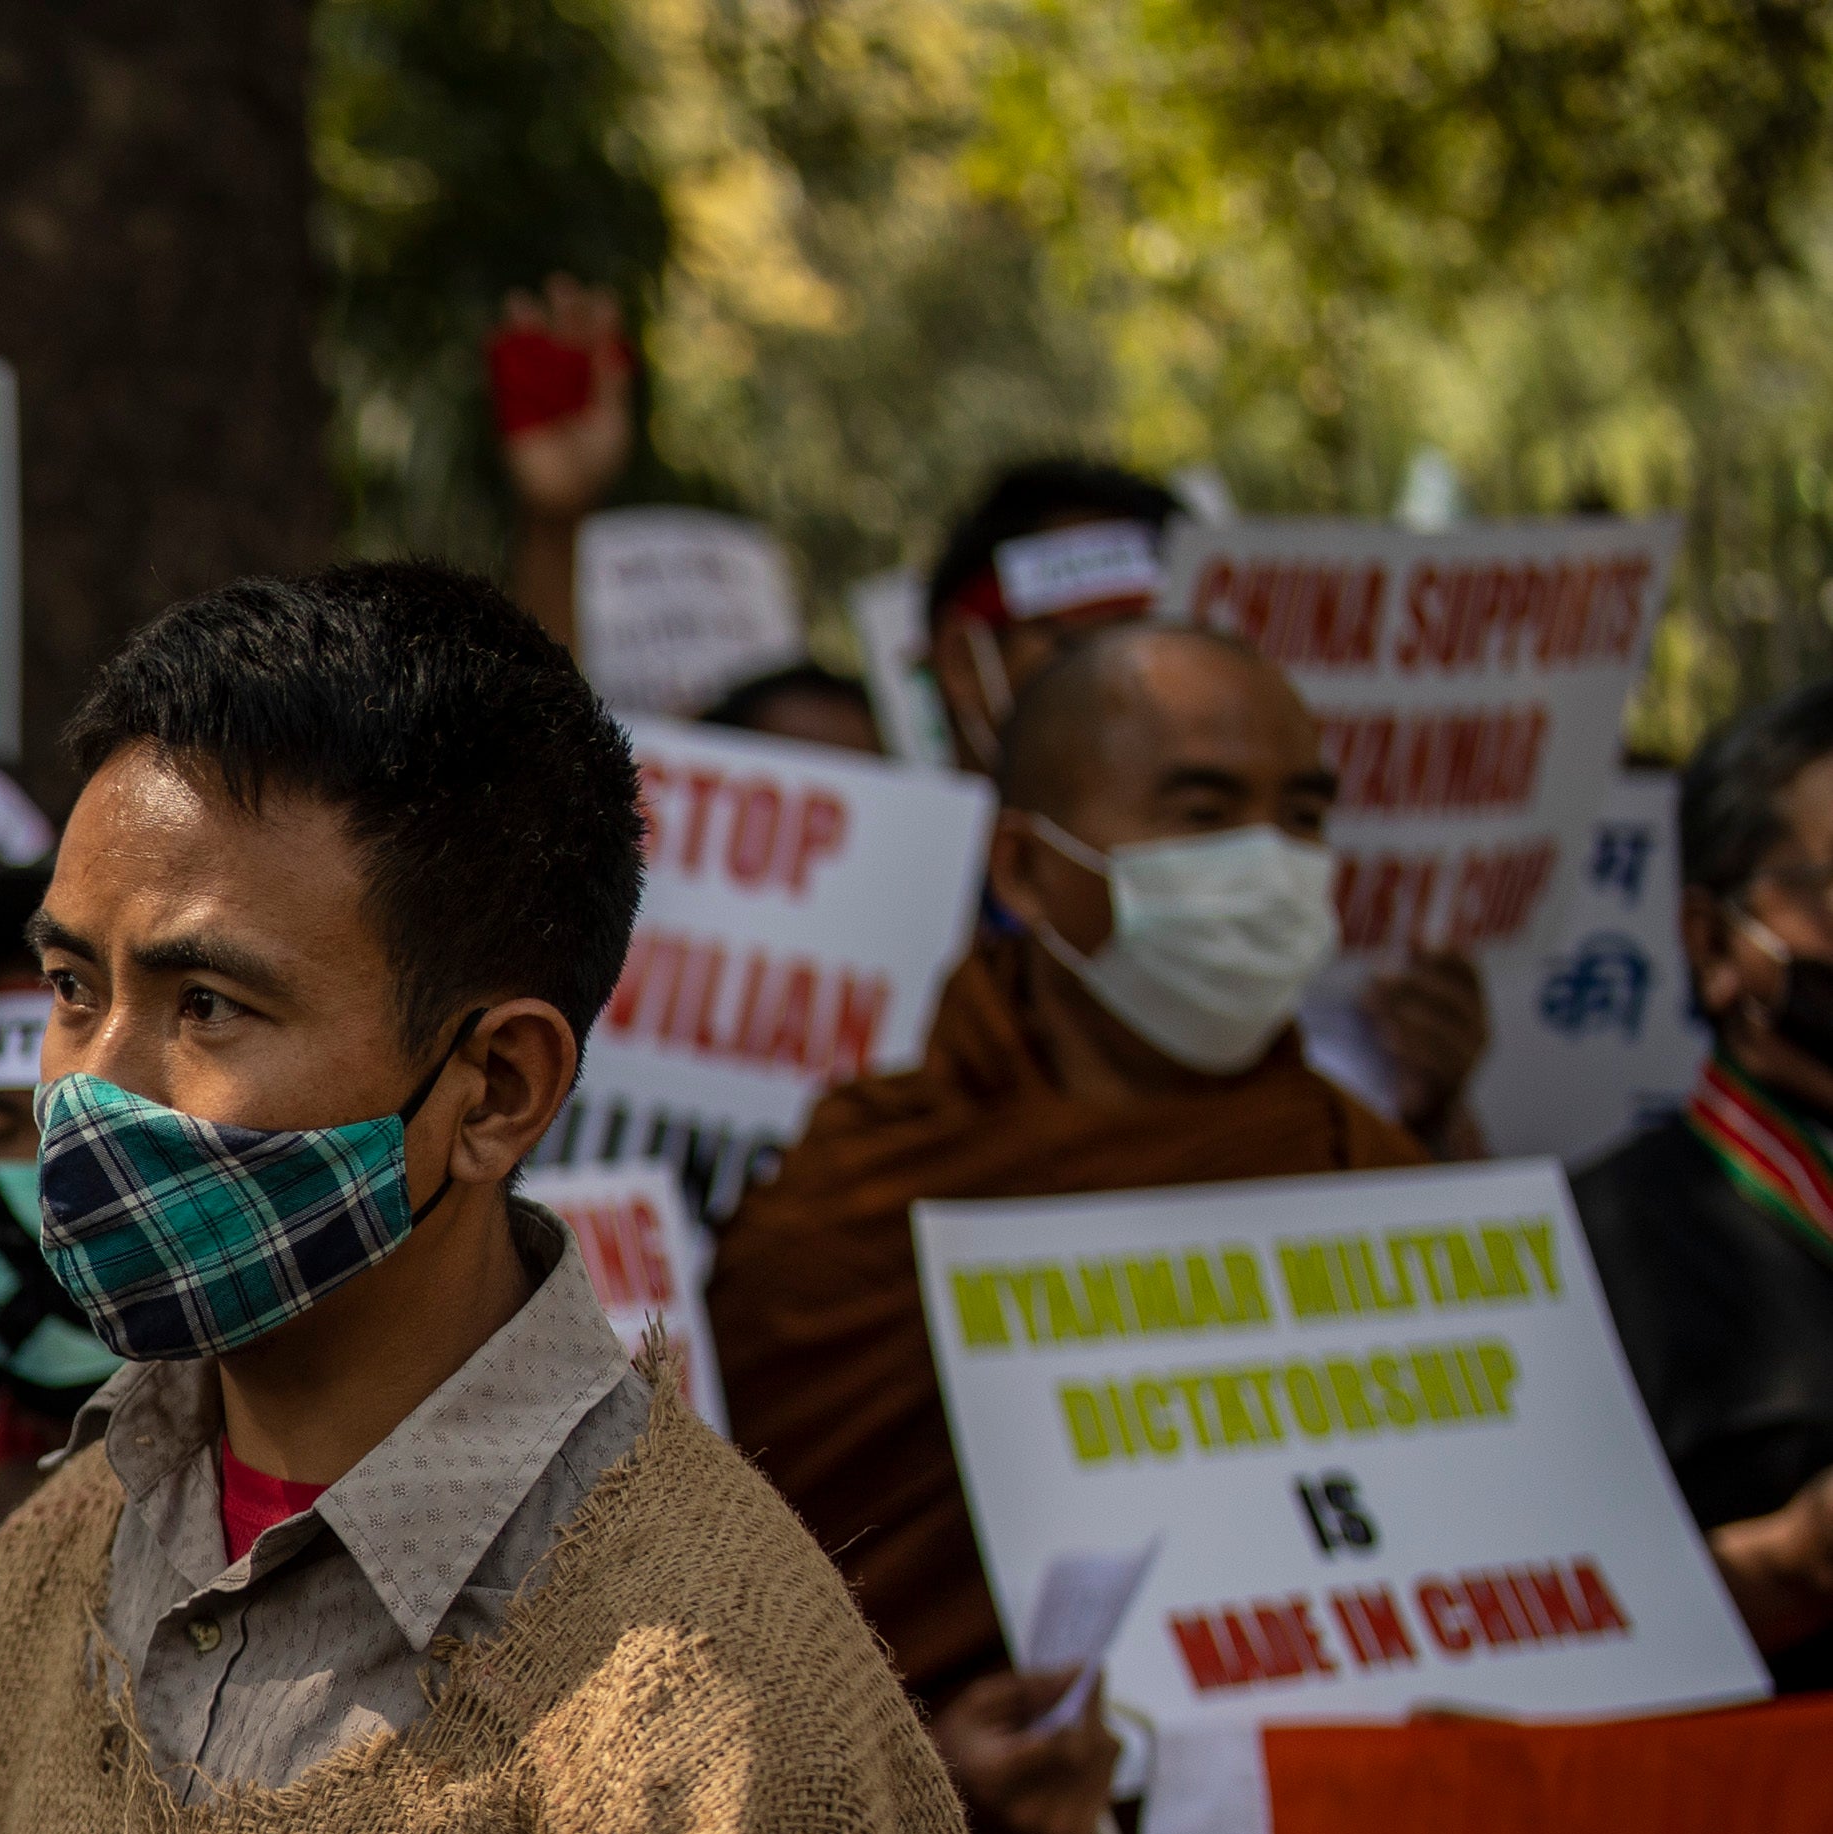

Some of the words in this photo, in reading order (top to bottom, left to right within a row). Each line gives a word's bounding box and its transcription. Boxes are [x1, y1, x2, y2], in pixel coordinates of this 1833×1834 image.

[949, 1241, 1273, 1356] MYANMAR
[1273, 1216, 1566, 1323] MILITARY
[1056, 1338, 1523, 1469] DICTATORSHIP
[1294, 1469, 1379, 1557] IS
[1168, 1590, 1340, 1696] MADE
[1333, 1582, 1418, 1674] IN
[1417, 1555, 1633, 1661] CHINA
